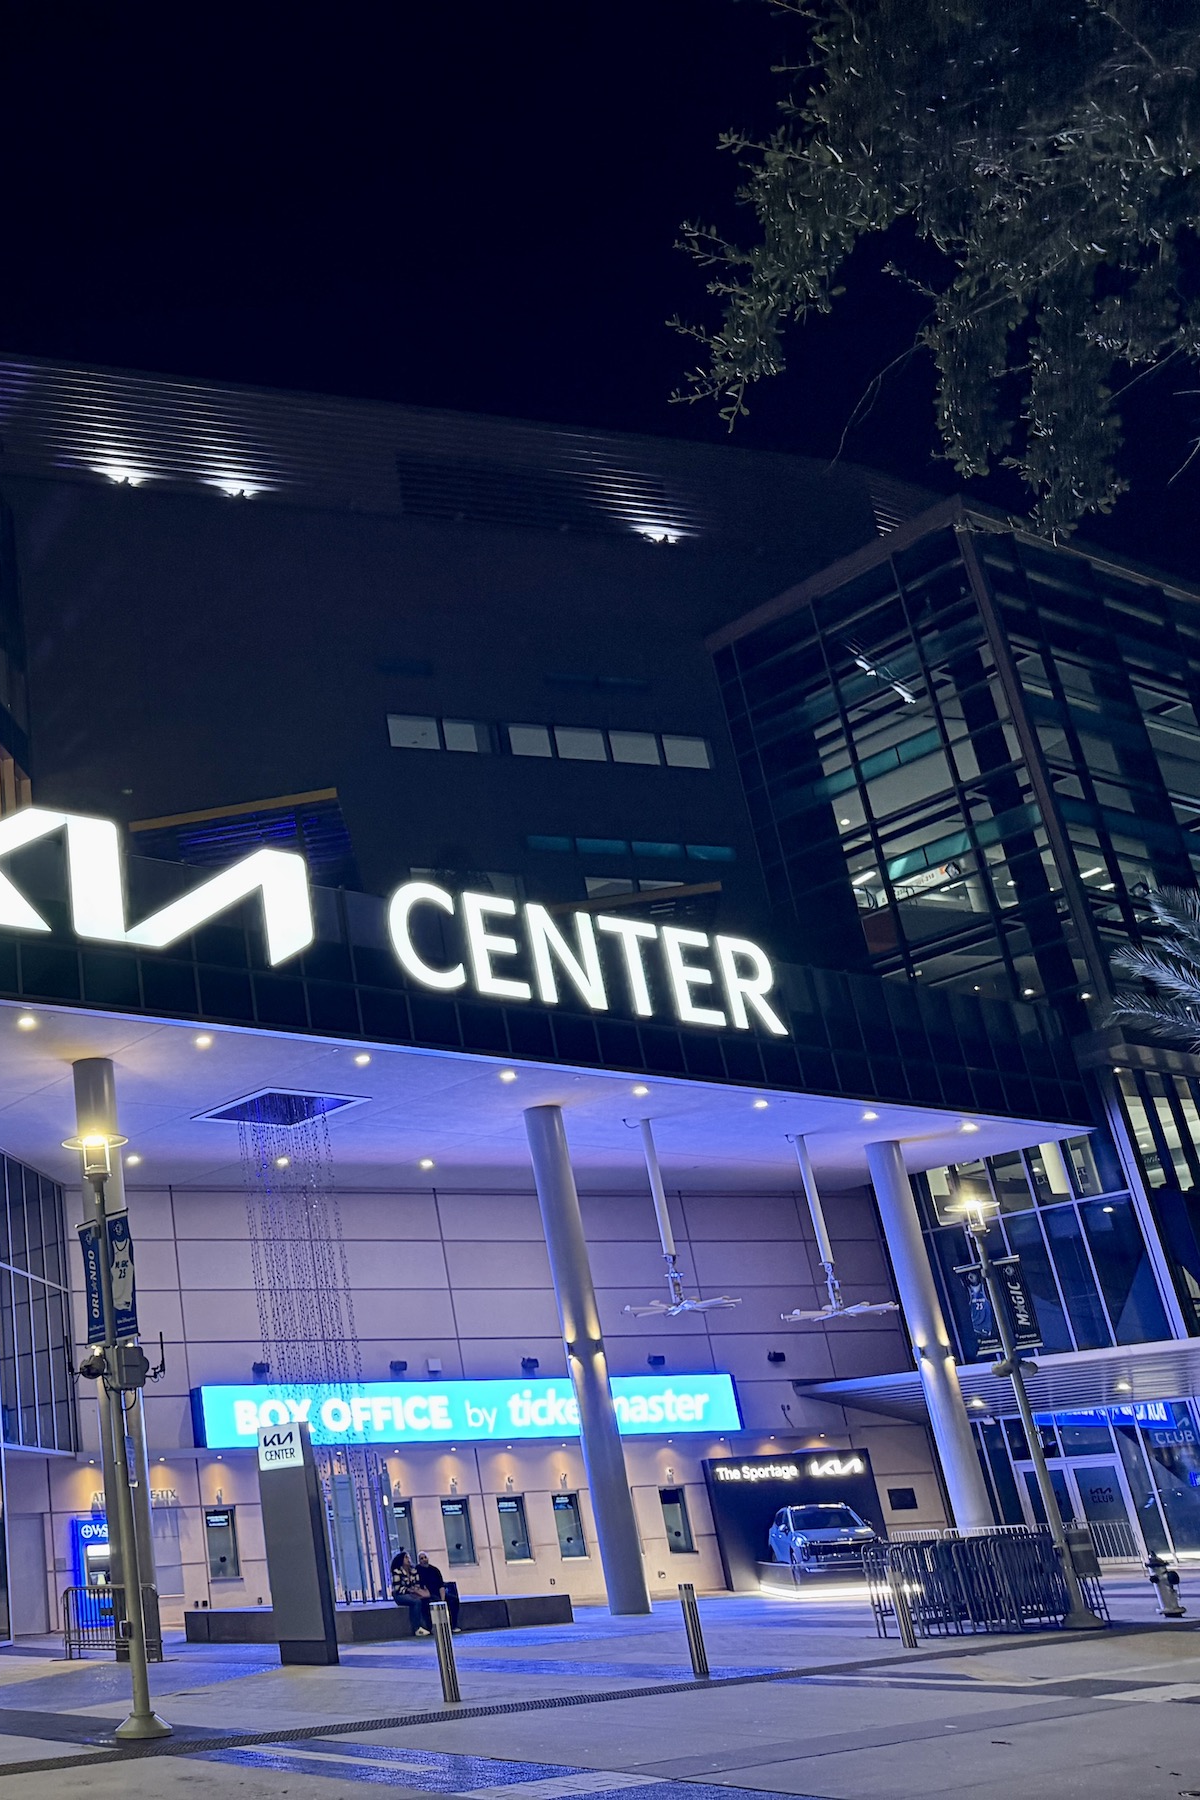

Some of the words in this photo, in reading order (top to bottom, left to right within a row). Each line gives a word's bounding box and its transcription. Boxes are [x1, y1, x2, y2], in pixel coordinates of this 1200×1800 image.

[388, 882, 789, 1036] CENTER
[88, 1250, 100, 1319] ORLANDO
[976, 1302, 984, 1311] 25
[1007, 1281, 1031, 1326] MAGIC
[234, 1398, 313, 1436] BOX
[320, 1395, 453, 1433] OFFICE
[465, 1402, 497, 1433] by
[1154, 1430, 1195, 1445] CLUB
[264, 1447, 295, 1462] CENTER
[716, 1467, 740, 1480] The
[742, 1464, 798, 1481] Sportage
